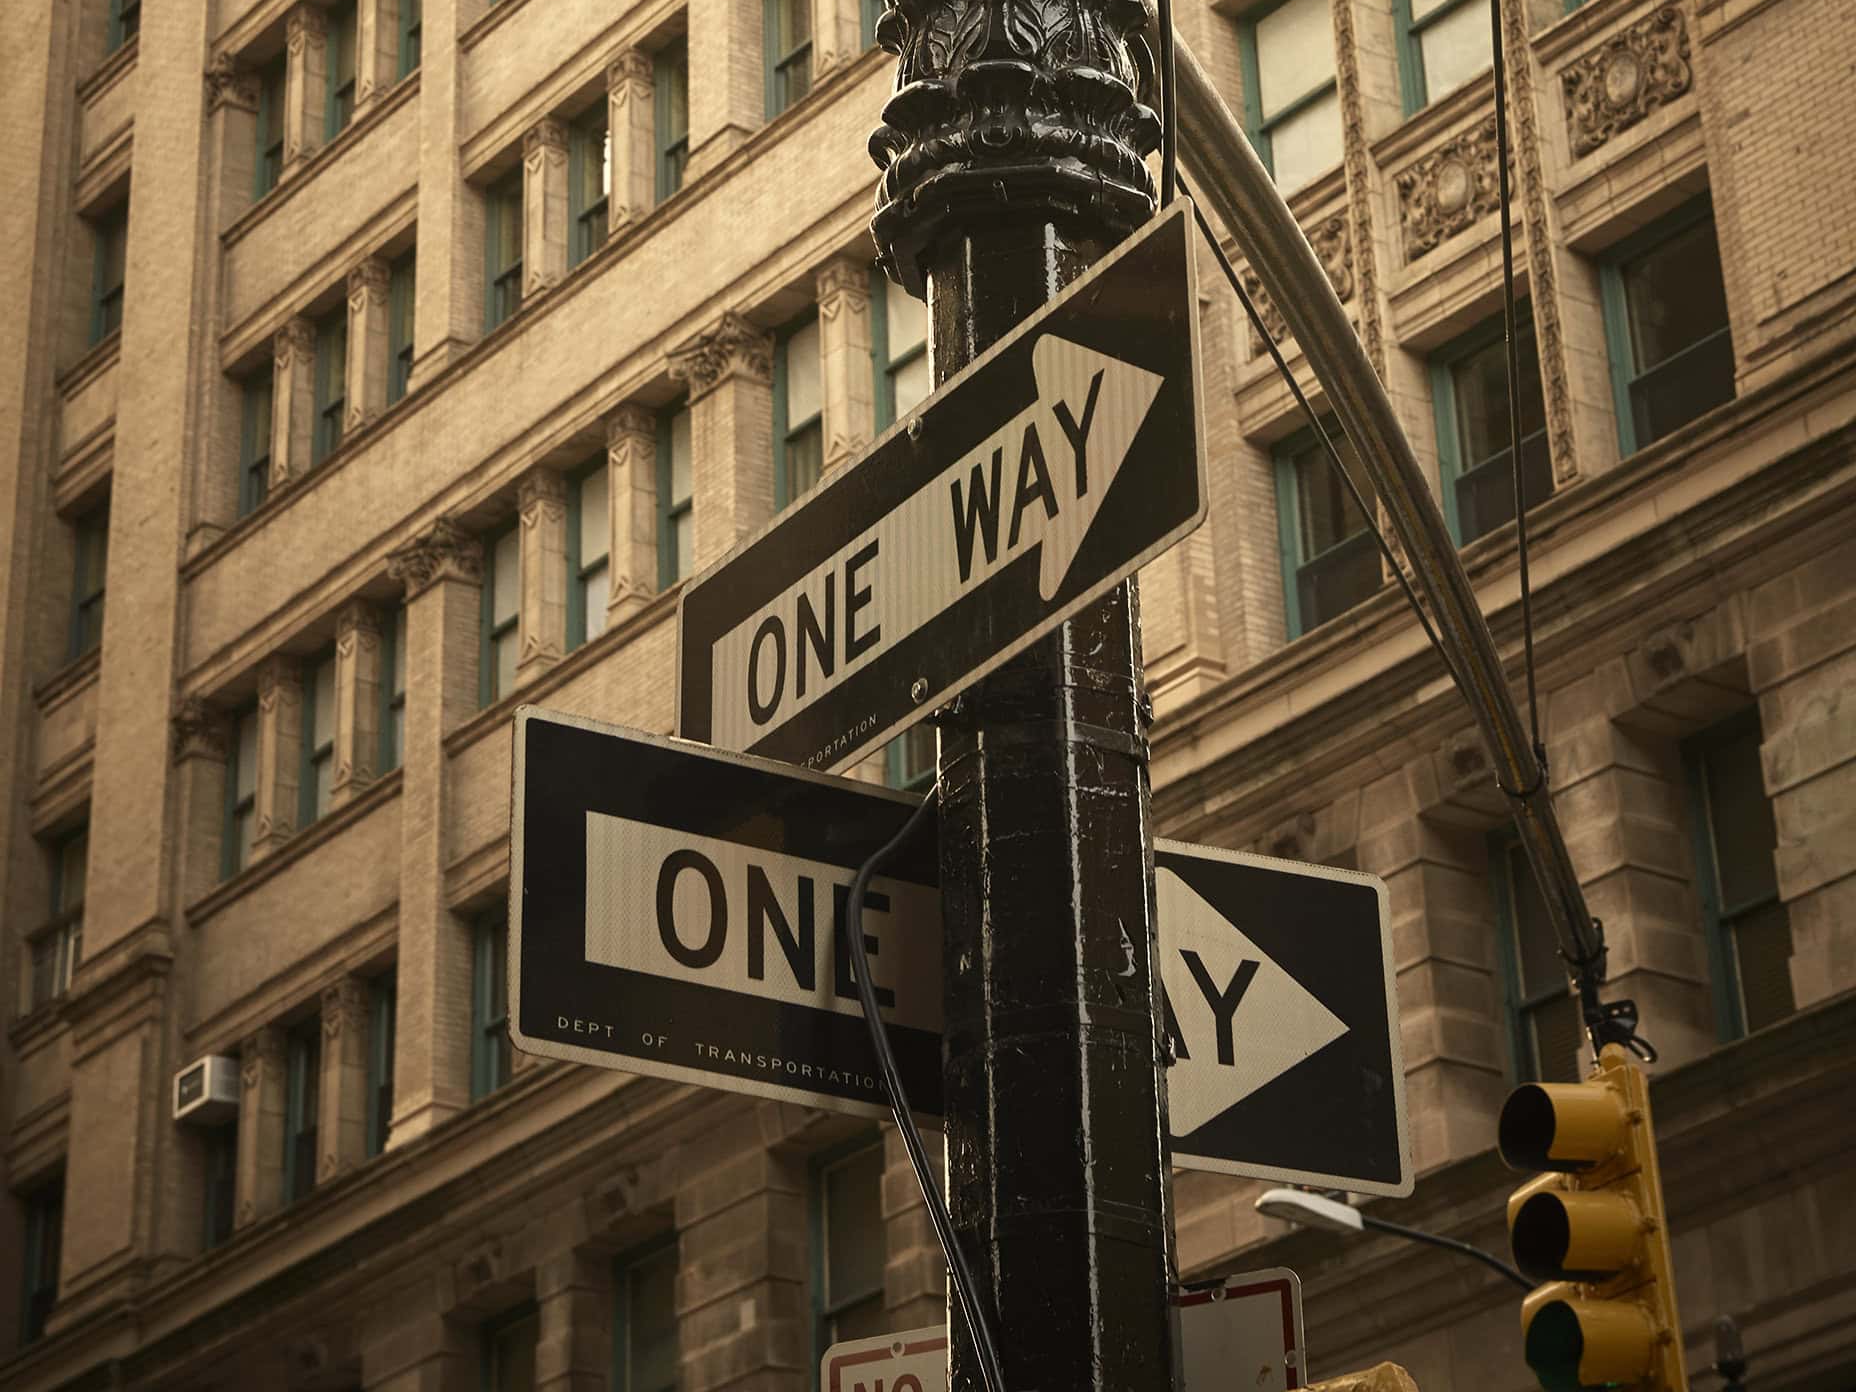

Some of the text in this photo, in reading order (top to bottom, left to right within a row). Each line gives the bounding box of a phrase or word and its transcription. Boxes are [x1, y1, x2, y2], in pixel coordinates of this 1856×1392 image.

[748, 367, 1104, 726] ONE WAY
[656, 848, 895, 1008] ONE
[557, 1015, 615, 1039] DEPT
[642, 1032, 669, 1049] OF
